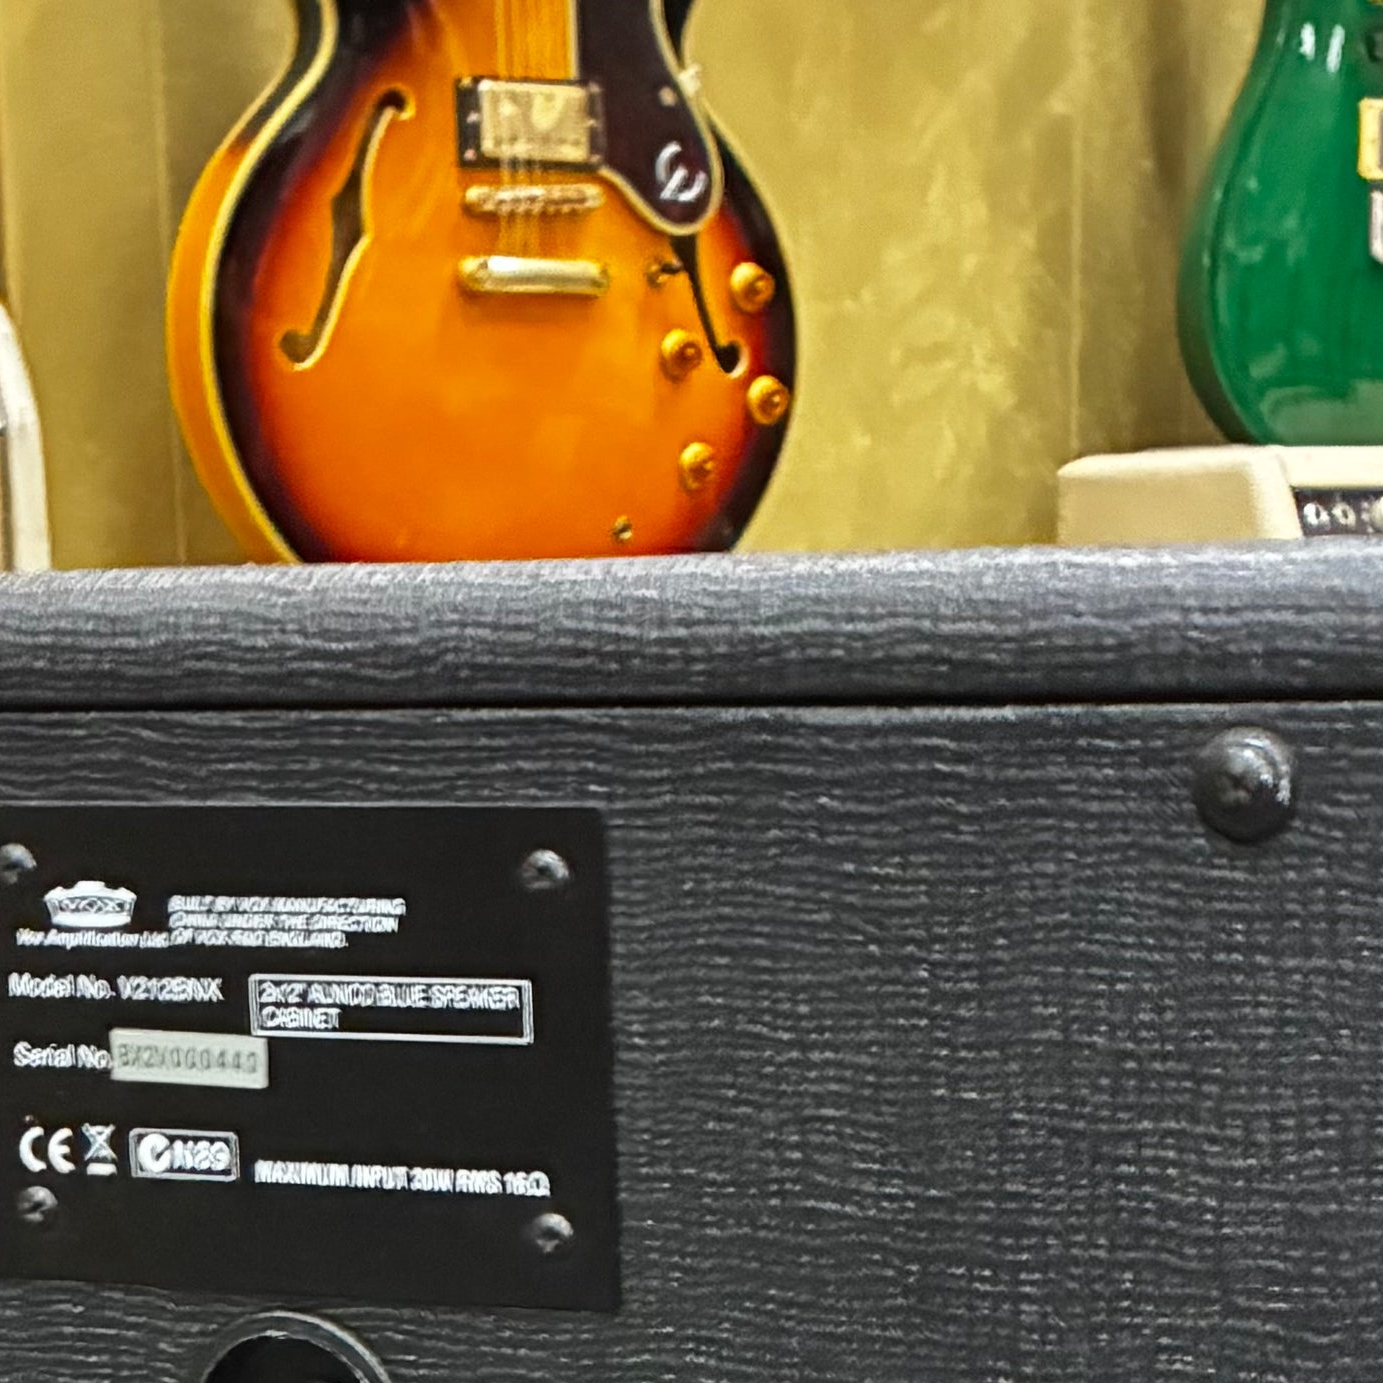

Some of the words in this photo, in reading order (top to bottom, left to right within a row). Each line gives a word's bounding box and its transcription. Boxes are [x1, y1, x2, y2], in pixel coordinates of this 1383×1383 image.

[8, 972, 74, 999] Model
[76, 974, 116, 1000] No.
[376, 983, 429, 1008] BLUE
[431, 984, 521, 1011] SPEAKER
[261, 1005, 342, 1029] CABINET
[13, 1041, 76, 1069] Serial
[19, 1126, 76, 1174] CE
[254, 1159, 350, 1188] MAXIMUM
[350, 1163, 409, 1190] INPUT
[455, 1168, 503, 1194] RMS
